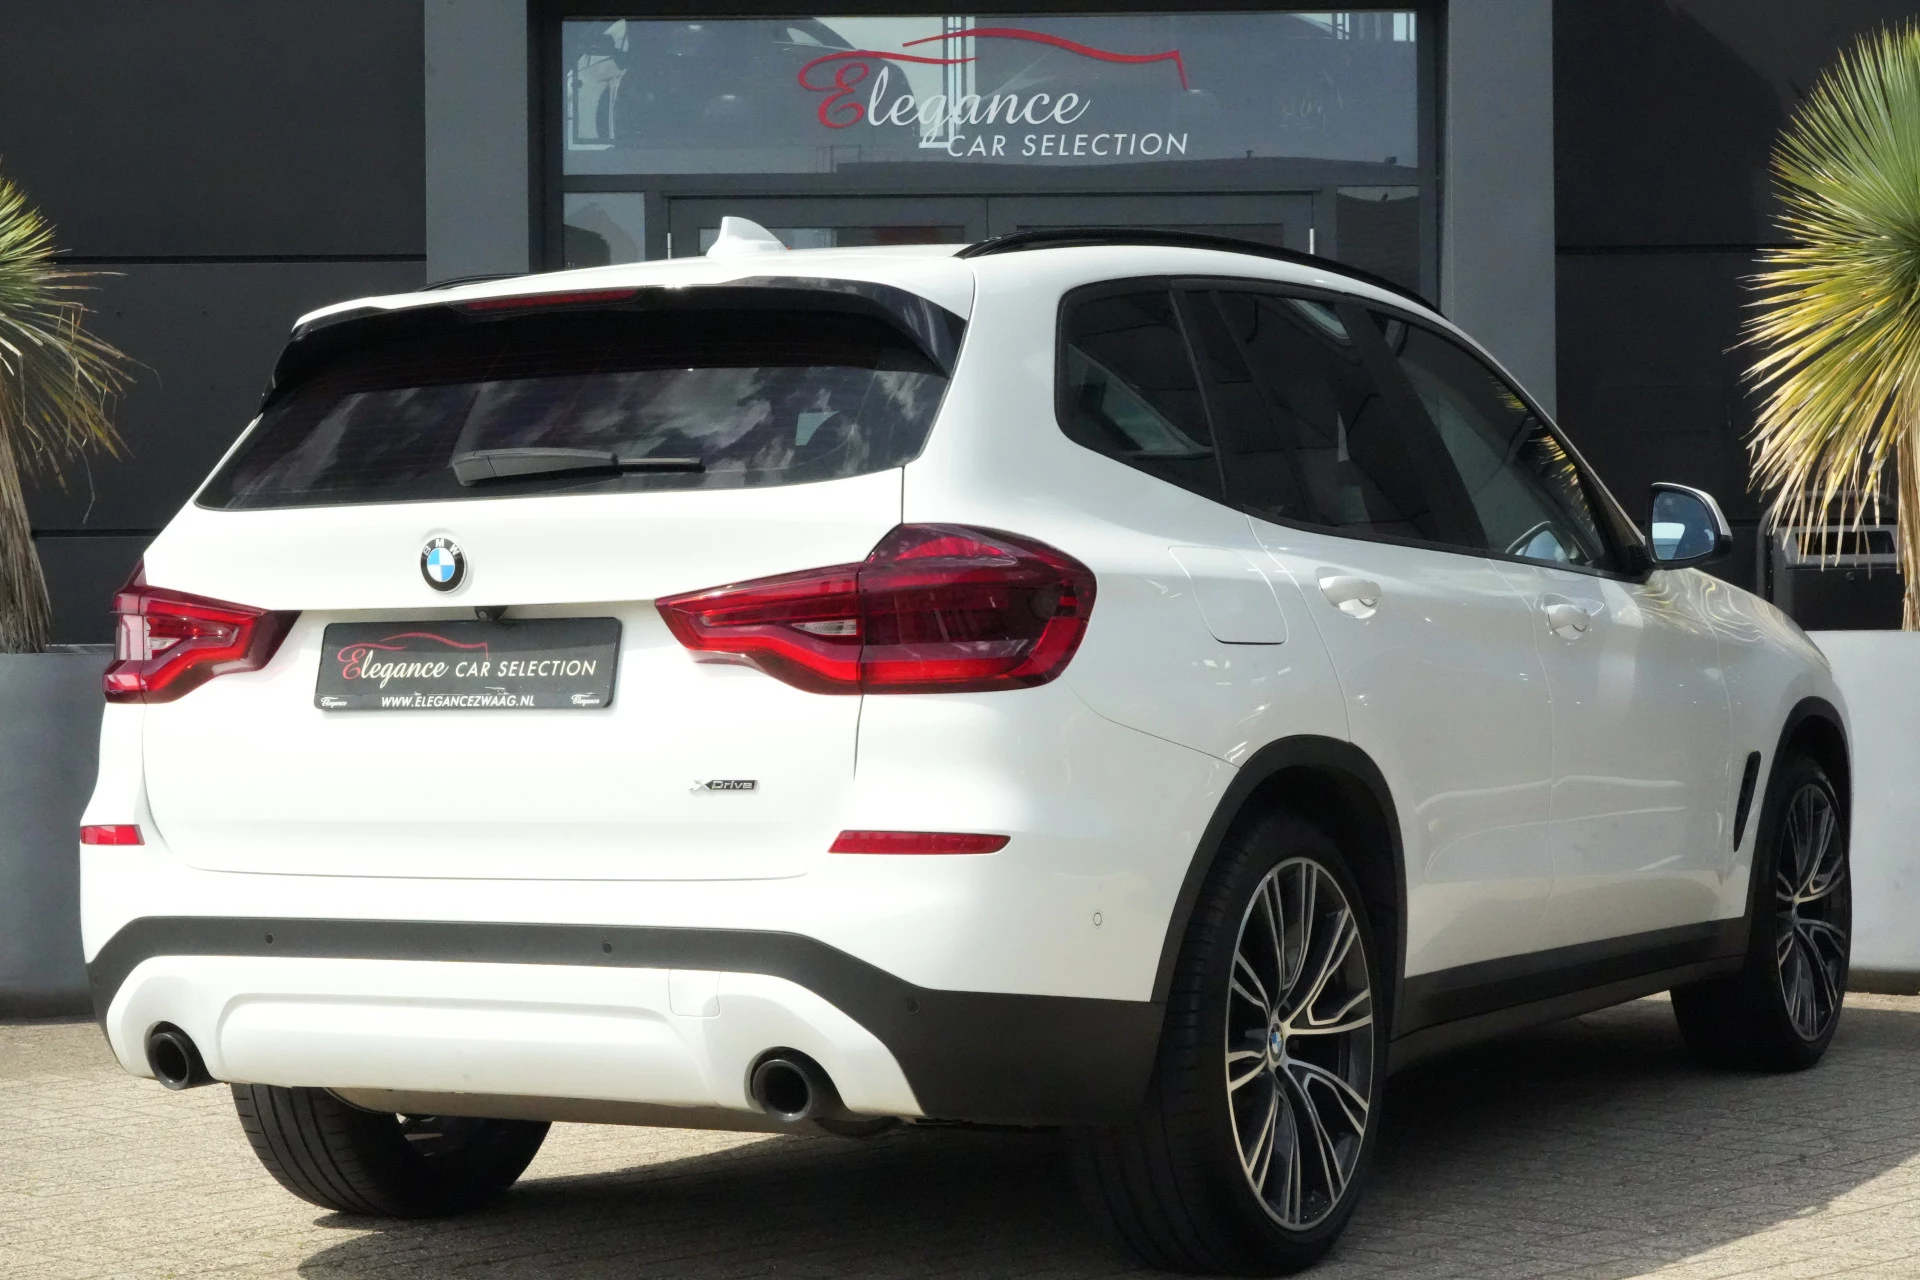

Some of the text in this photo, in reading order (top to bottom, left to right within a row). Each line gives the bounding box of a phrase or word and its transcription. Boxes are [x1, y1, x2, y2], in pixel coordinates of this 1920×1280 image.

[798, 49, 1091, 144] Elegance
[947, 133, 1188, 158] CAR SELECTION
[423, 538, 461, 556] BMW
[337, 643, 597, 688] Elegance CAR SELECTION
[381, 694, 535, 708] WWW.ELEGANCEZWAAG.NL
